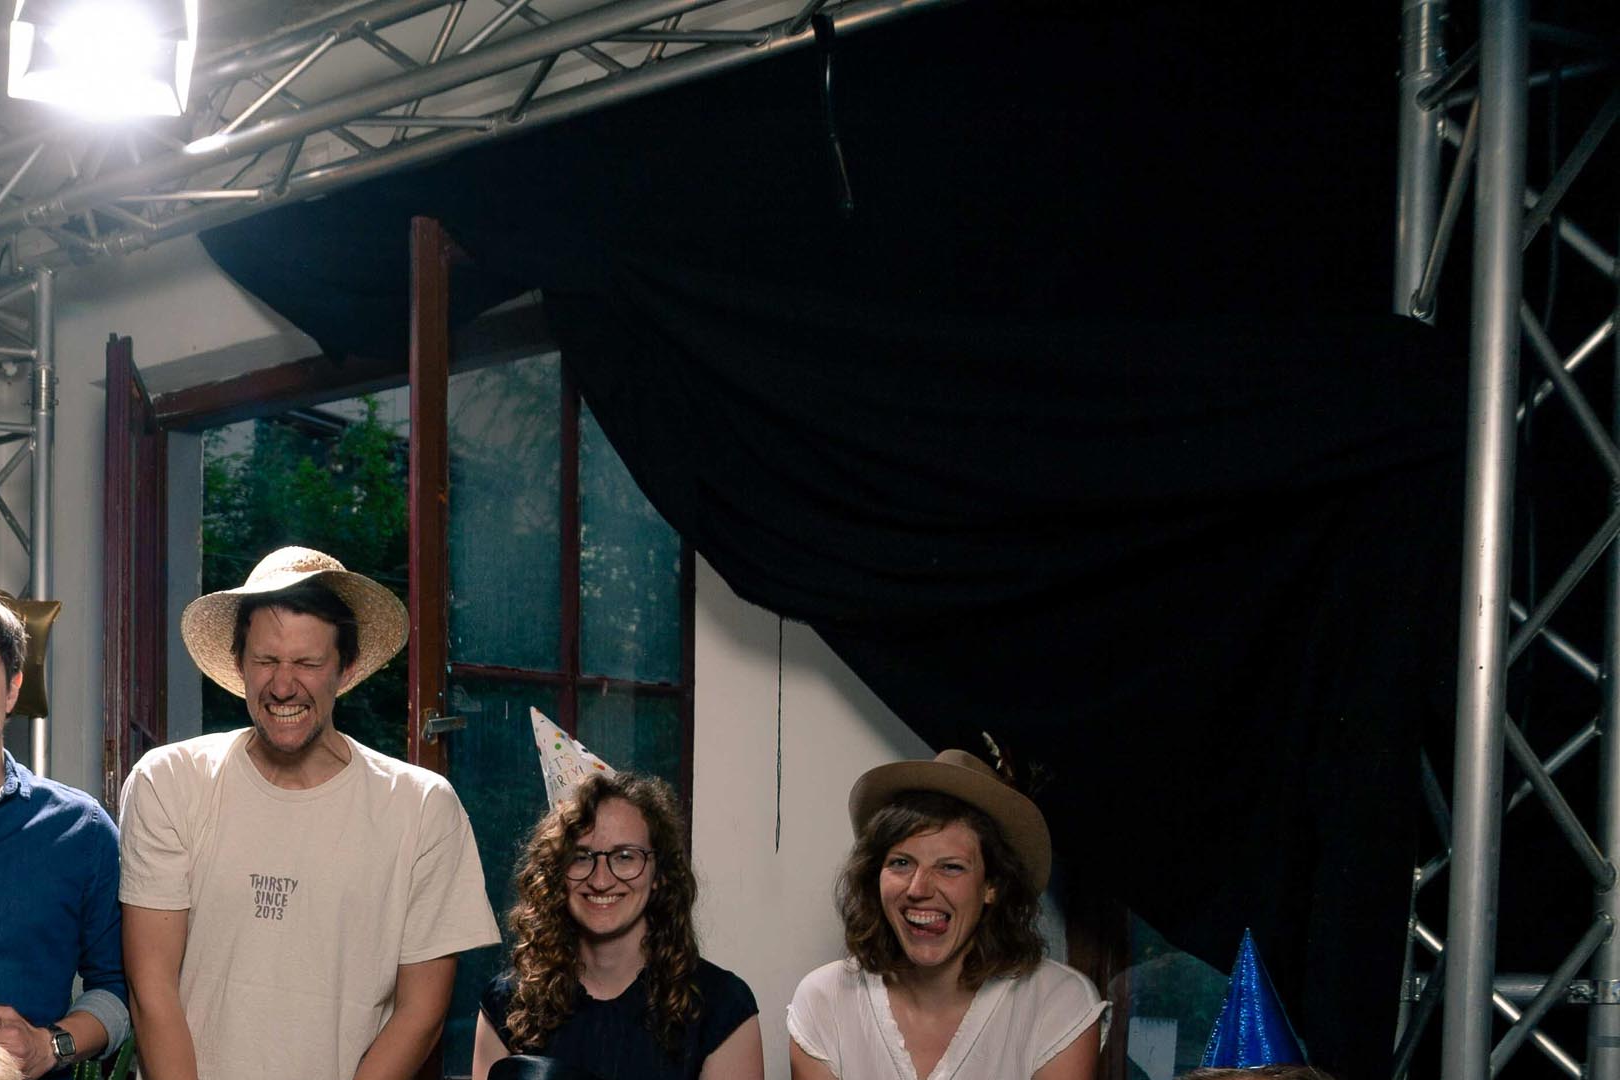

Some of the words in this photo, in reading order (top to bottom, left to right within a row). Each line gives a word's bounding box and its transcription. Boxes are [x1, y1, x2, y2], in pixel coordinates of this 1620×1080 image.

[249, 874, 298, 895] THIRSTY
[254, 890, 288, 907] SINCE
[255, 905, 284, 921] 2013
